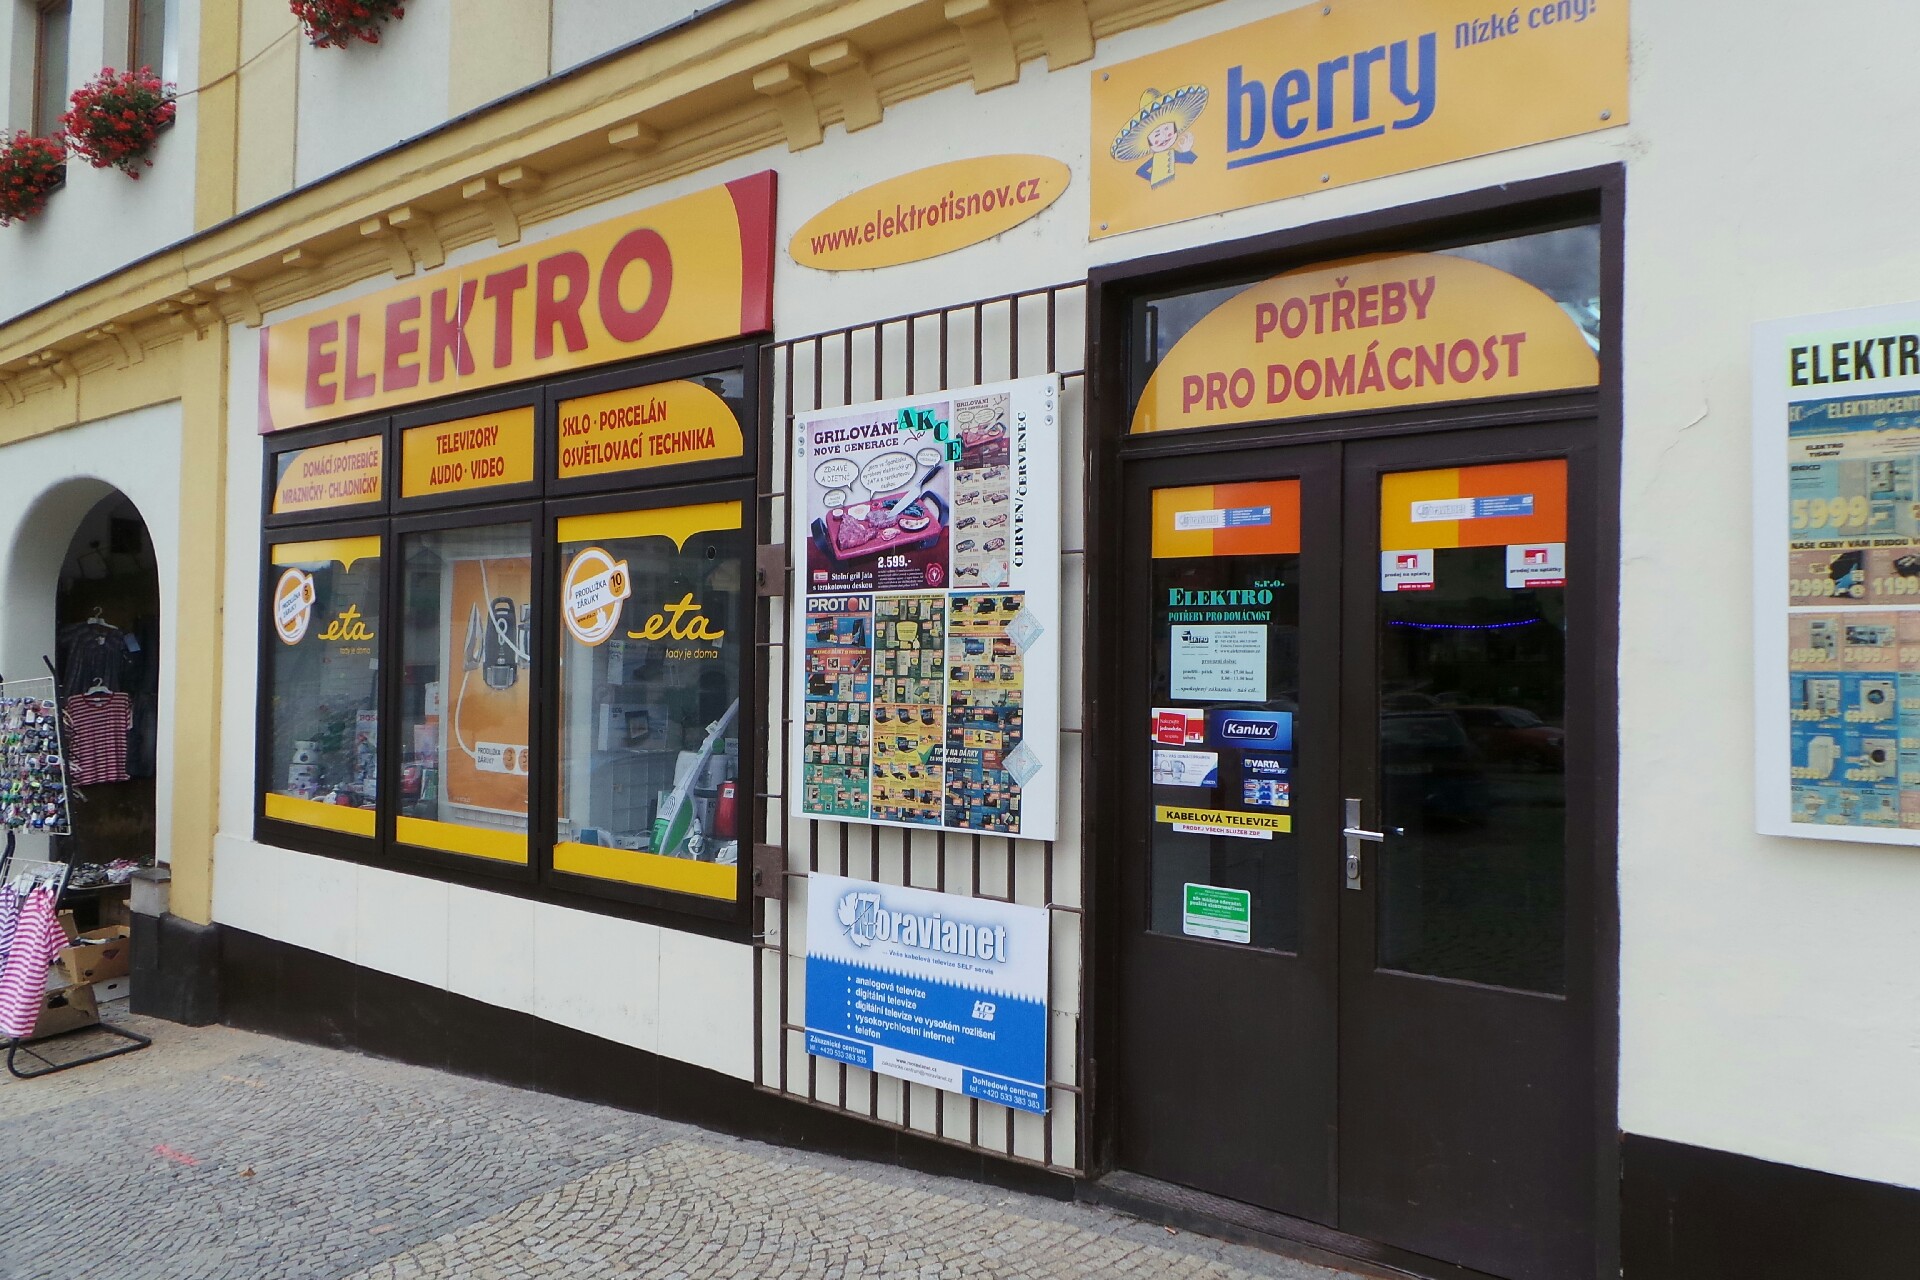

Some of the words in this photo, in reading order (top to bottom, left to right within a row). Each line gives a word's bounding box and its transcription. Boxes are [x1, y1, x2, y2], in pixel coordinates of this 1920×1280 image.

[1455, 7, 1519, 49] Nízké
[1227, 31, 1437, 152] berry
[810, 175, 1041, 256] www.elektrotisnov.cz
[305, 228, 673, 408] ELEKTRO
[1255, 274, 1436, 344] POTŘEBY
[1182, 368, 1256, 414] PRO
[1265, 332, 1527, 402] DOMÁCNOST
[563, 414, 591, 437] SKLO
[600, 397, 667, 431] PORCELÁN
[437, 425, 499, 455] TELEVIZORY
[814, 419, 898, 444] GRILOVÁNÍ
[898, 409, 962, 462] AKCE
[563, 432, 643, 468] OSVĚTLOVACÍ
[649, 427, 715, 456] TECHNIKA
[814, 444, 840, 456] NOVÉ
[845, 438, 899, 453] GENERACE
[303, 455, 333, 479] DOMÁCÍ
[430, 465, 463, 486] AUDIO
[471, 456, 504, 480] VIDEO
[329, 472, 378, 498] CHLADNIČKY
[1791, 541, 1816, 549] NAŠE
[1874, 538, 1909, 547] BUDOU
[610, 572, 622, 587] 10
[1254, 580, 1285, 588] s.r.o.
[318, 604, 374, 642] eta
[628, 593, 724, 641] eta
[1168, 609, 1204, 621] POTŘEBY
[1206, 611, 1222, 621] PRO
[1224, 609, 1271, 621] DOMÁCNOST
[693, 648, 718, 659] doma
[1227, 723, 1275, 736] Kanlux
[1251, 759, 1280, 768] VARTA
[1166, 811, 1223, 823] KABELOVÁ
[1226, 816, 1279, 827] TELEVIZE
[1205, 825, 1225, 833] VŠECH
[957, 962, 973, 971] SELF
[855, 976, 894, 992] analogová
[896, 984, 926, 999] televize
[855, 987, 886, 1004] digitální
[887, 994, 917, 1009] televize
[855, 999, 884, 1015] digitální
[884, 1006, 913, 1021] televize
[913, 1015, 924, 1024] ve
[924, 1017, 960, 1033] vysokém
[961, 1026, 996, 1041] rozlišení
[855, 1013, 921, 1037] vysokorychlostní
[923, 1029, 955, 1044] internet
[855, 1024, 881, 1039] telefon
[810, 1034, 842, 1050] Zákaznické
[842, 1044, 866, 1056] centrum
[972, 1076, 1008, 1092] Dohledové
[1009, 1087, 1038, 1099] centrum
[982, 1089, 998, 1099] +420
[1000, 1093, 1013, 1102] 533
[1013, 1096, 1026, 1106] 383
[1028, 1100, 1040, 1109] 383
